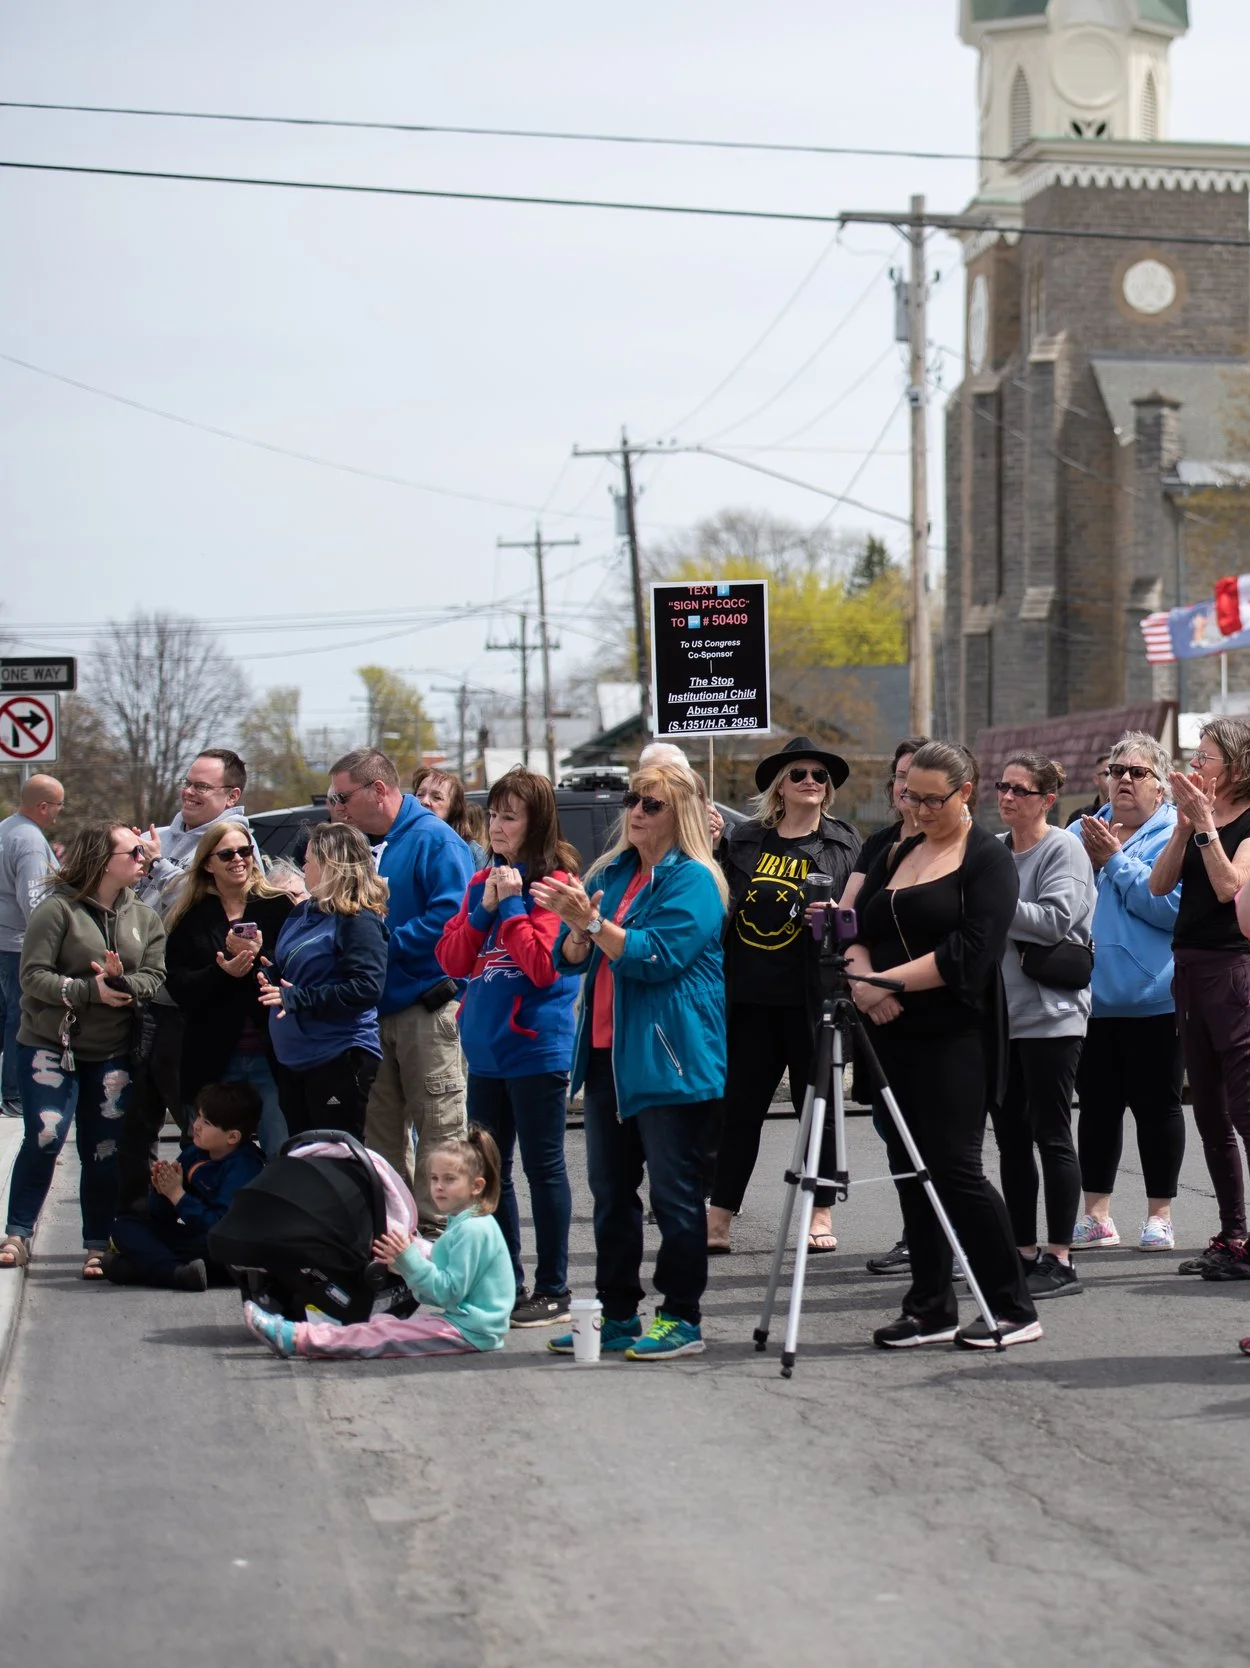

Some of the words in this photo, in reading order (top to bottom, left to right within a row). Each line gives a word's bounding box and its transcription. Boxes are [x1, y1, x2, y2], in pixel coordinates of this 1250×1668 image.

[688, 586, 715, 595] TEXT
[671, 618, 686, 627] TO
[703, 616, 710, 626] #
[712, 613, 748, 626] 50409
[680, 641, 690, 649] To
[691, 640, 703, 648] US
[704, 639, 741, 648] Congress
[688, 651, 733, 661] Co-Sponsor
[1, 667, 28, 681] ONE
[33, 667, 62, 681] WAY
[689, 677, 708, 687] The
[711, 676, 734, 686] Stop
[668, 690, 728, 702] Institutional
[730, 688, 757, 699] Child
[687, 705, 719, 715] Abuse
[721, 704, 739, 714] Act
[668, 718, 728, 732] (S.1351/H.R.
[732, 716, 758, 728] 2955)
[756, 852, 813, 880] IRVAN
